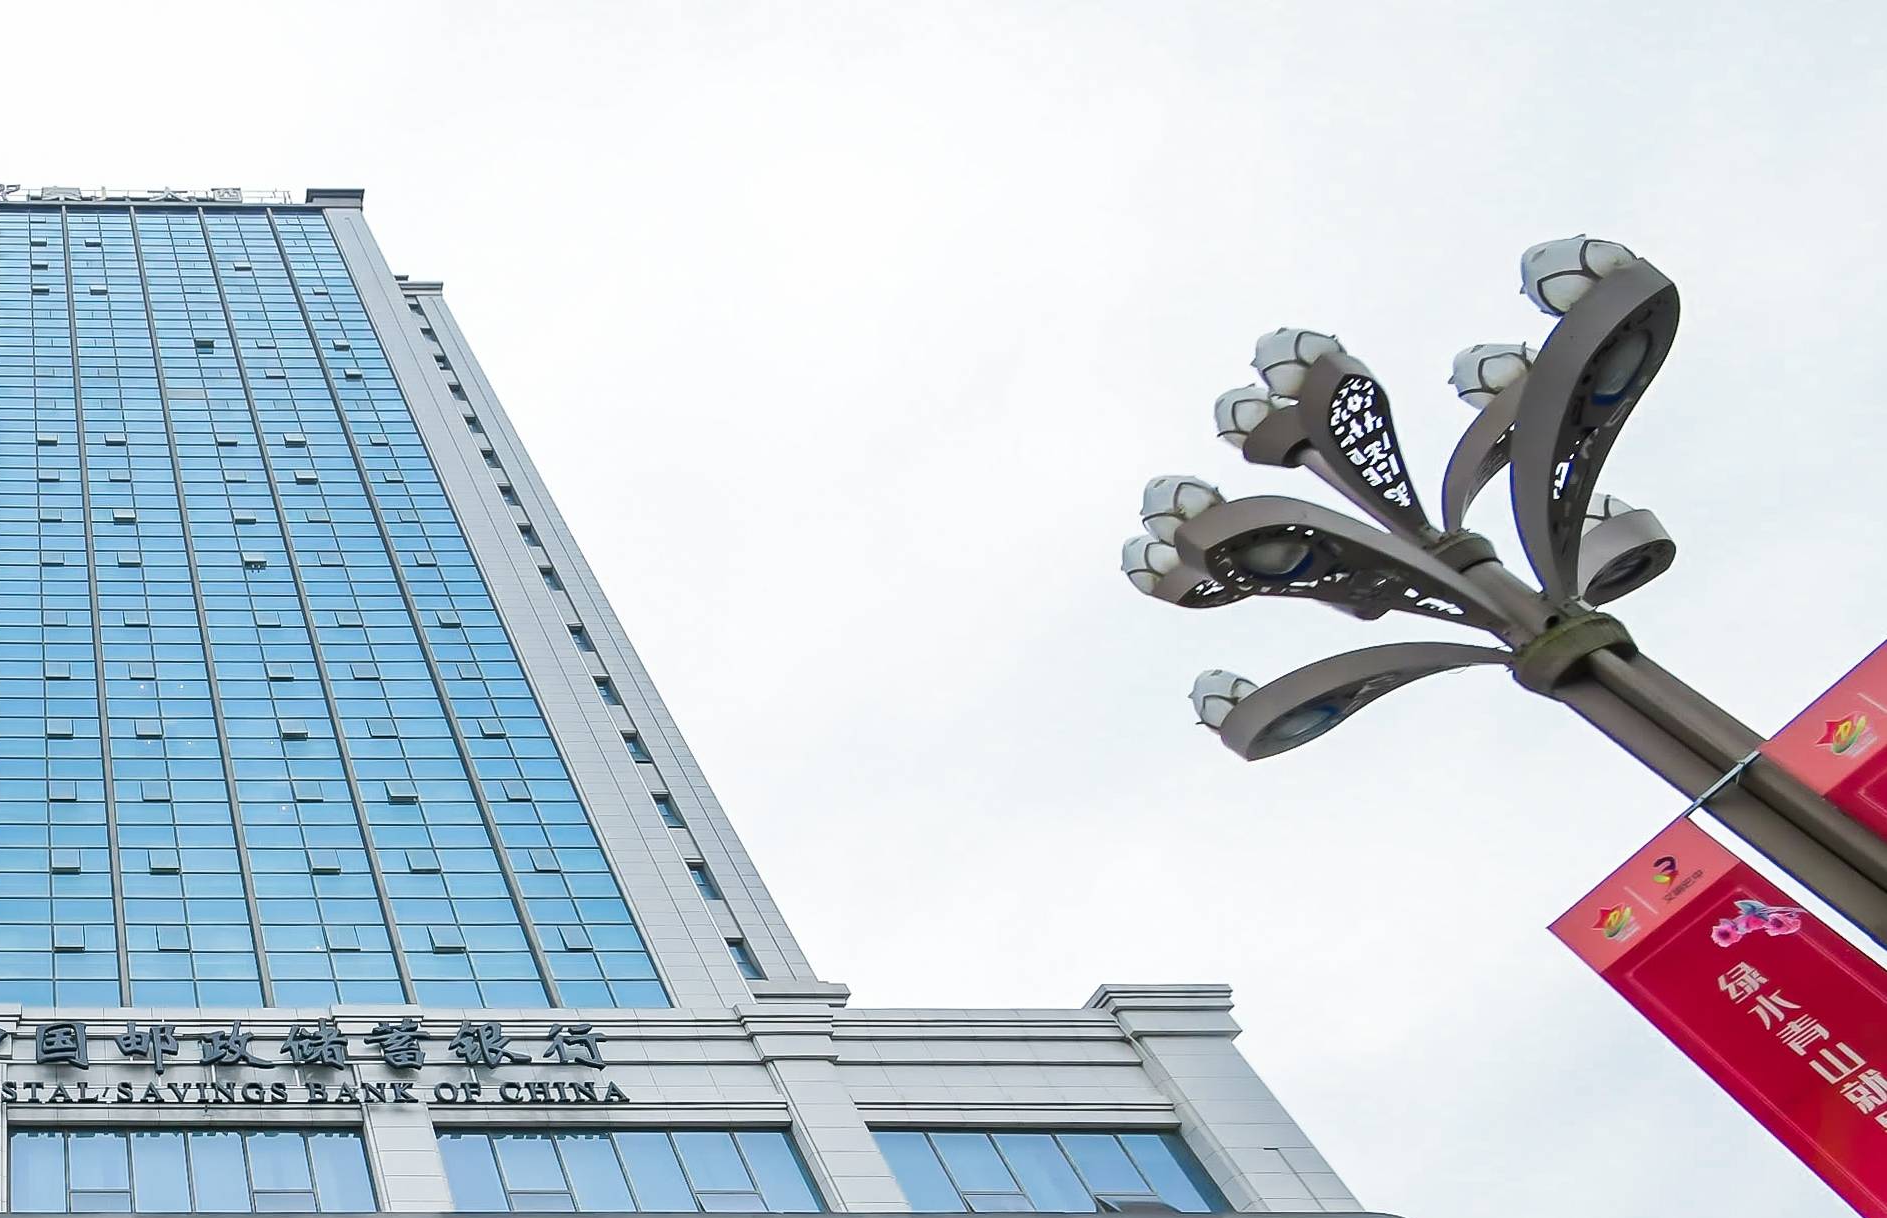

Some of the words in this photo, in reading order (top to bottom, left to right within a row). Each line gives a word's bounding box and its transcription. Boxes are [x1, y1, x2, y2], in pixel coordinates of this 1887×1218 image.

[115, 1080, 289, 1105] SAVINGS
[311, 1080, 419, 1105] BANK
[433, 1080, 481, 1105] OF
[499, 1080, 632, 1105] CHINA
[1717, 960, 1887, 1133] 绿水青山就
